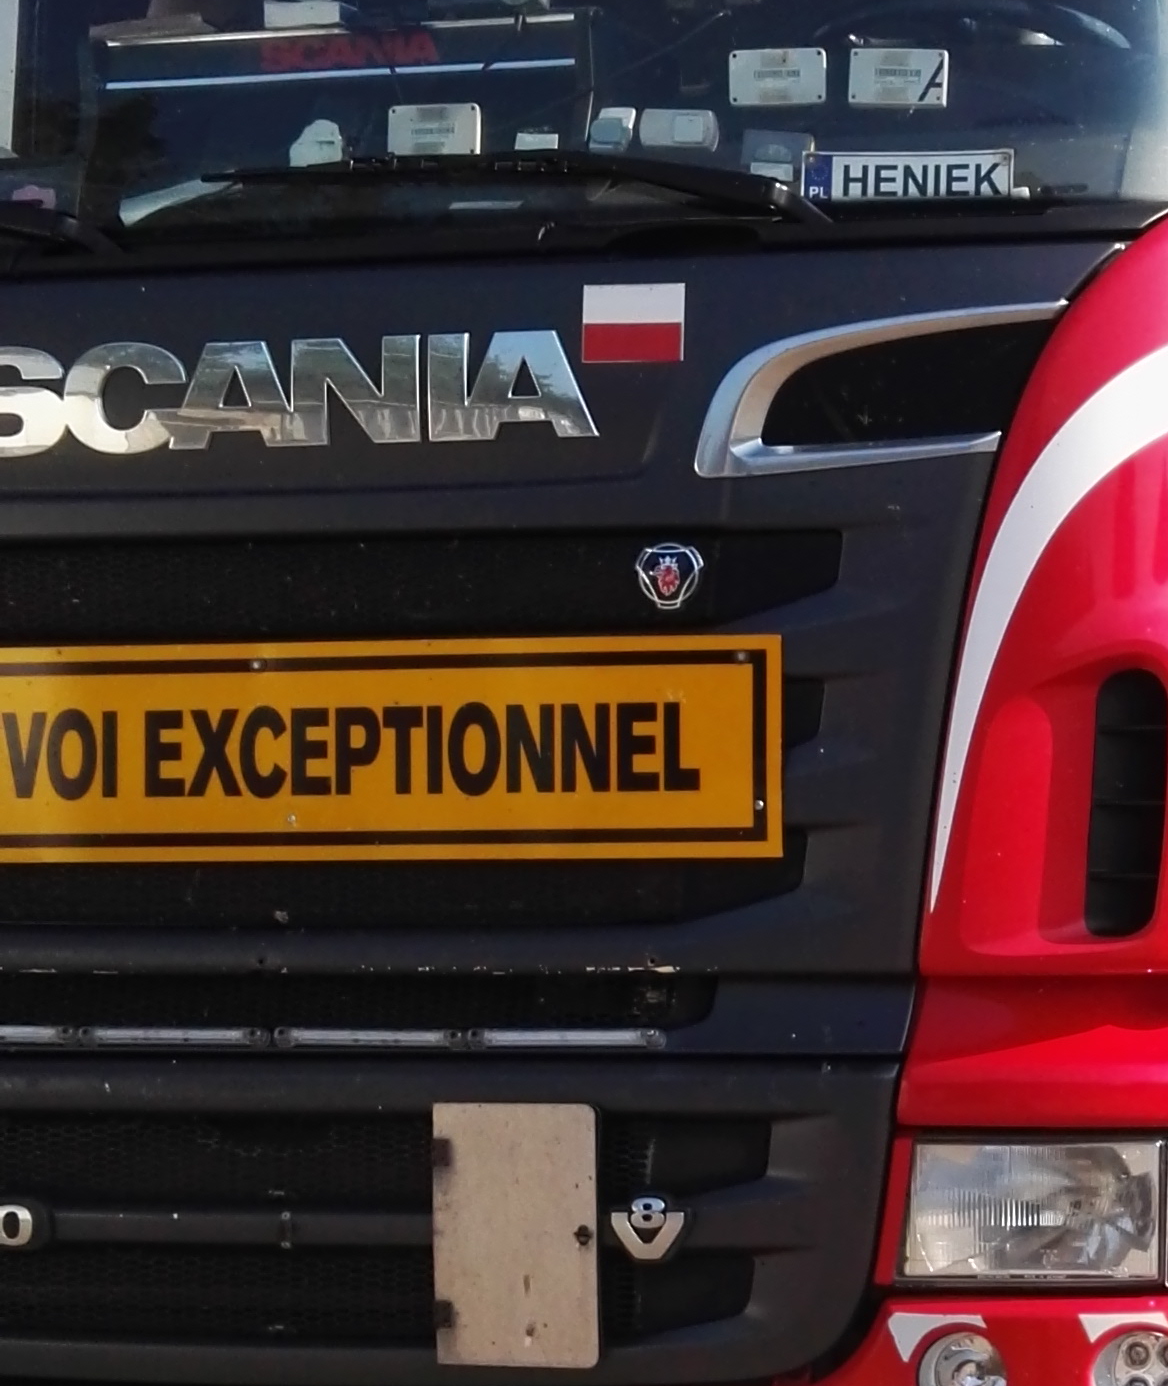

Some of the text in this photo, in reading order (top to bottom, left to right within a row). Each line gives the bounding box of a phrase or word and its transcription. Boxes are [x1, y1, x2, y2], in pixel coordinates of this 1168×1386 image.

[809, 161, 1003, 199] PL HENIEK
[1, 701, 701, 801] VOI EXCEPTIONNEL
